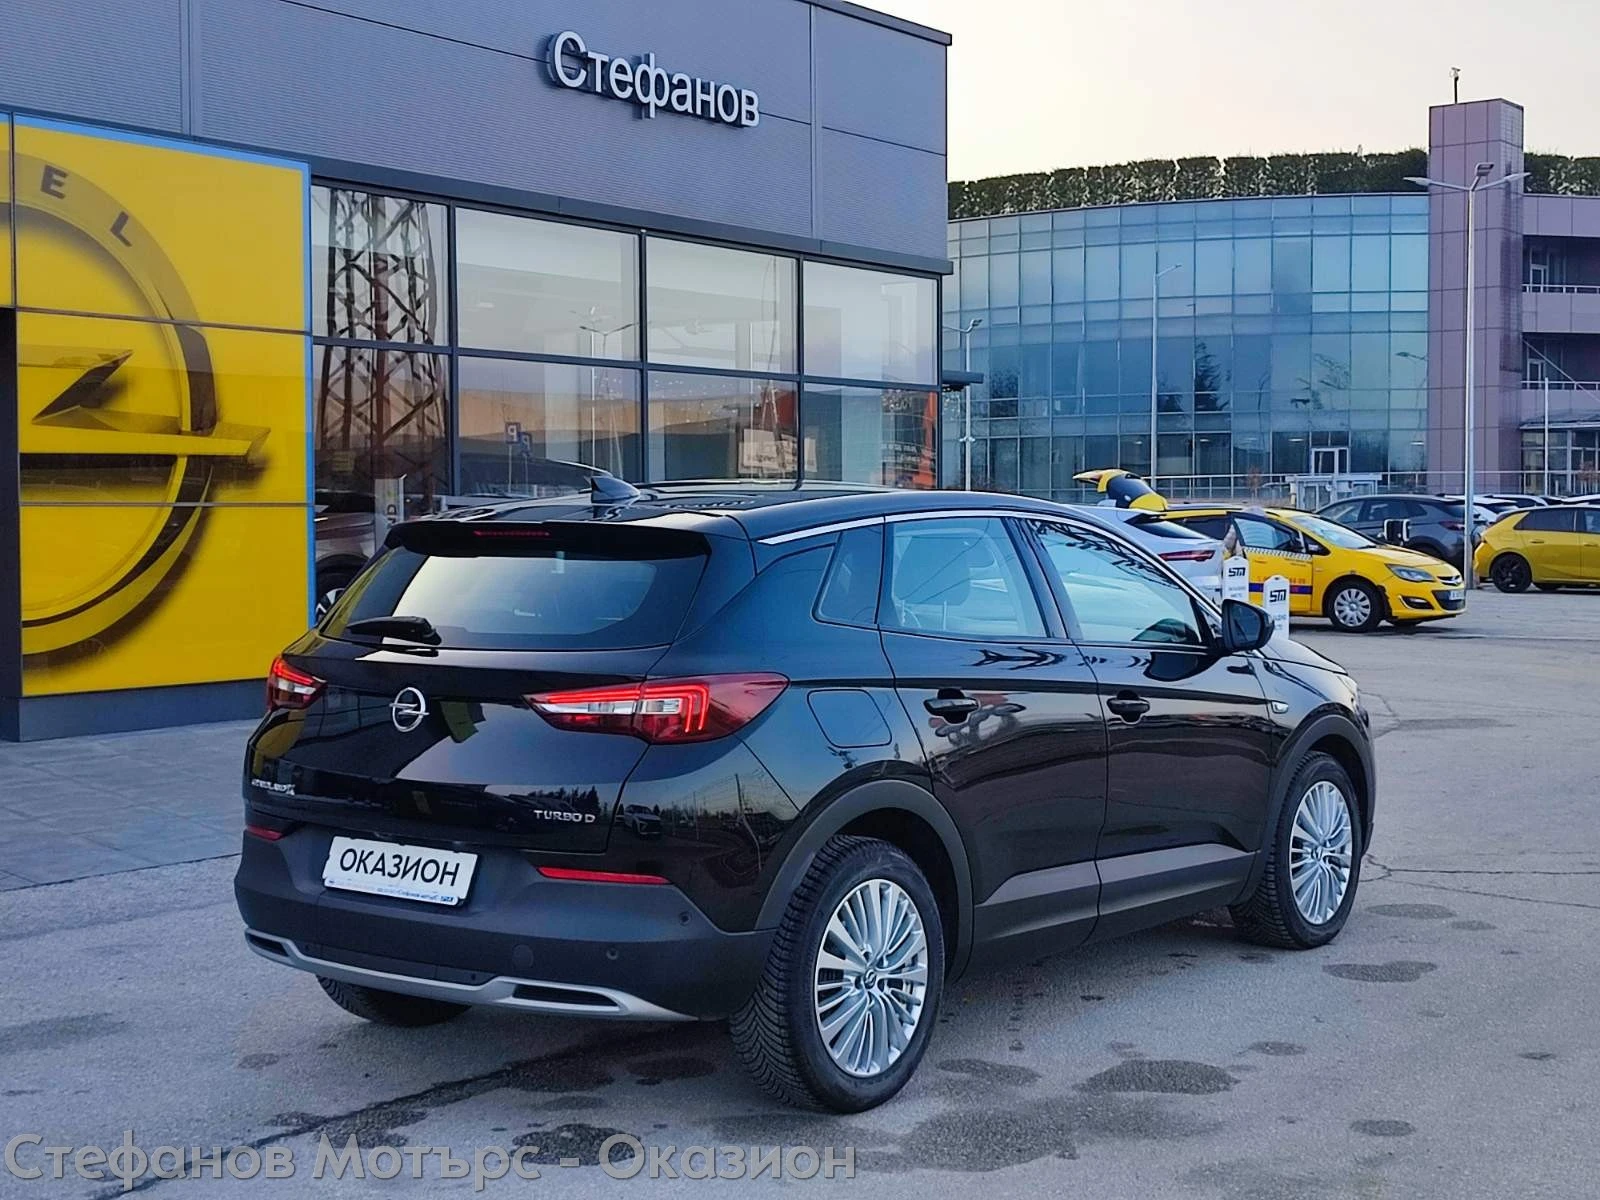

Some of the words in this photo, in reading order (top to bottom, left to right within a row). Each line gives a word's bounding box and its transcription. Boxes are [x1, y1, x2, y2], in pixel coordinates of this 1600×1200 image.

[552, 30, 760, 128] Стефанов
[533, 809, 583, 823] TURBO
[584, 813, 596, 824] D
[339, 848, 460, 887] ОКАЗИОН
